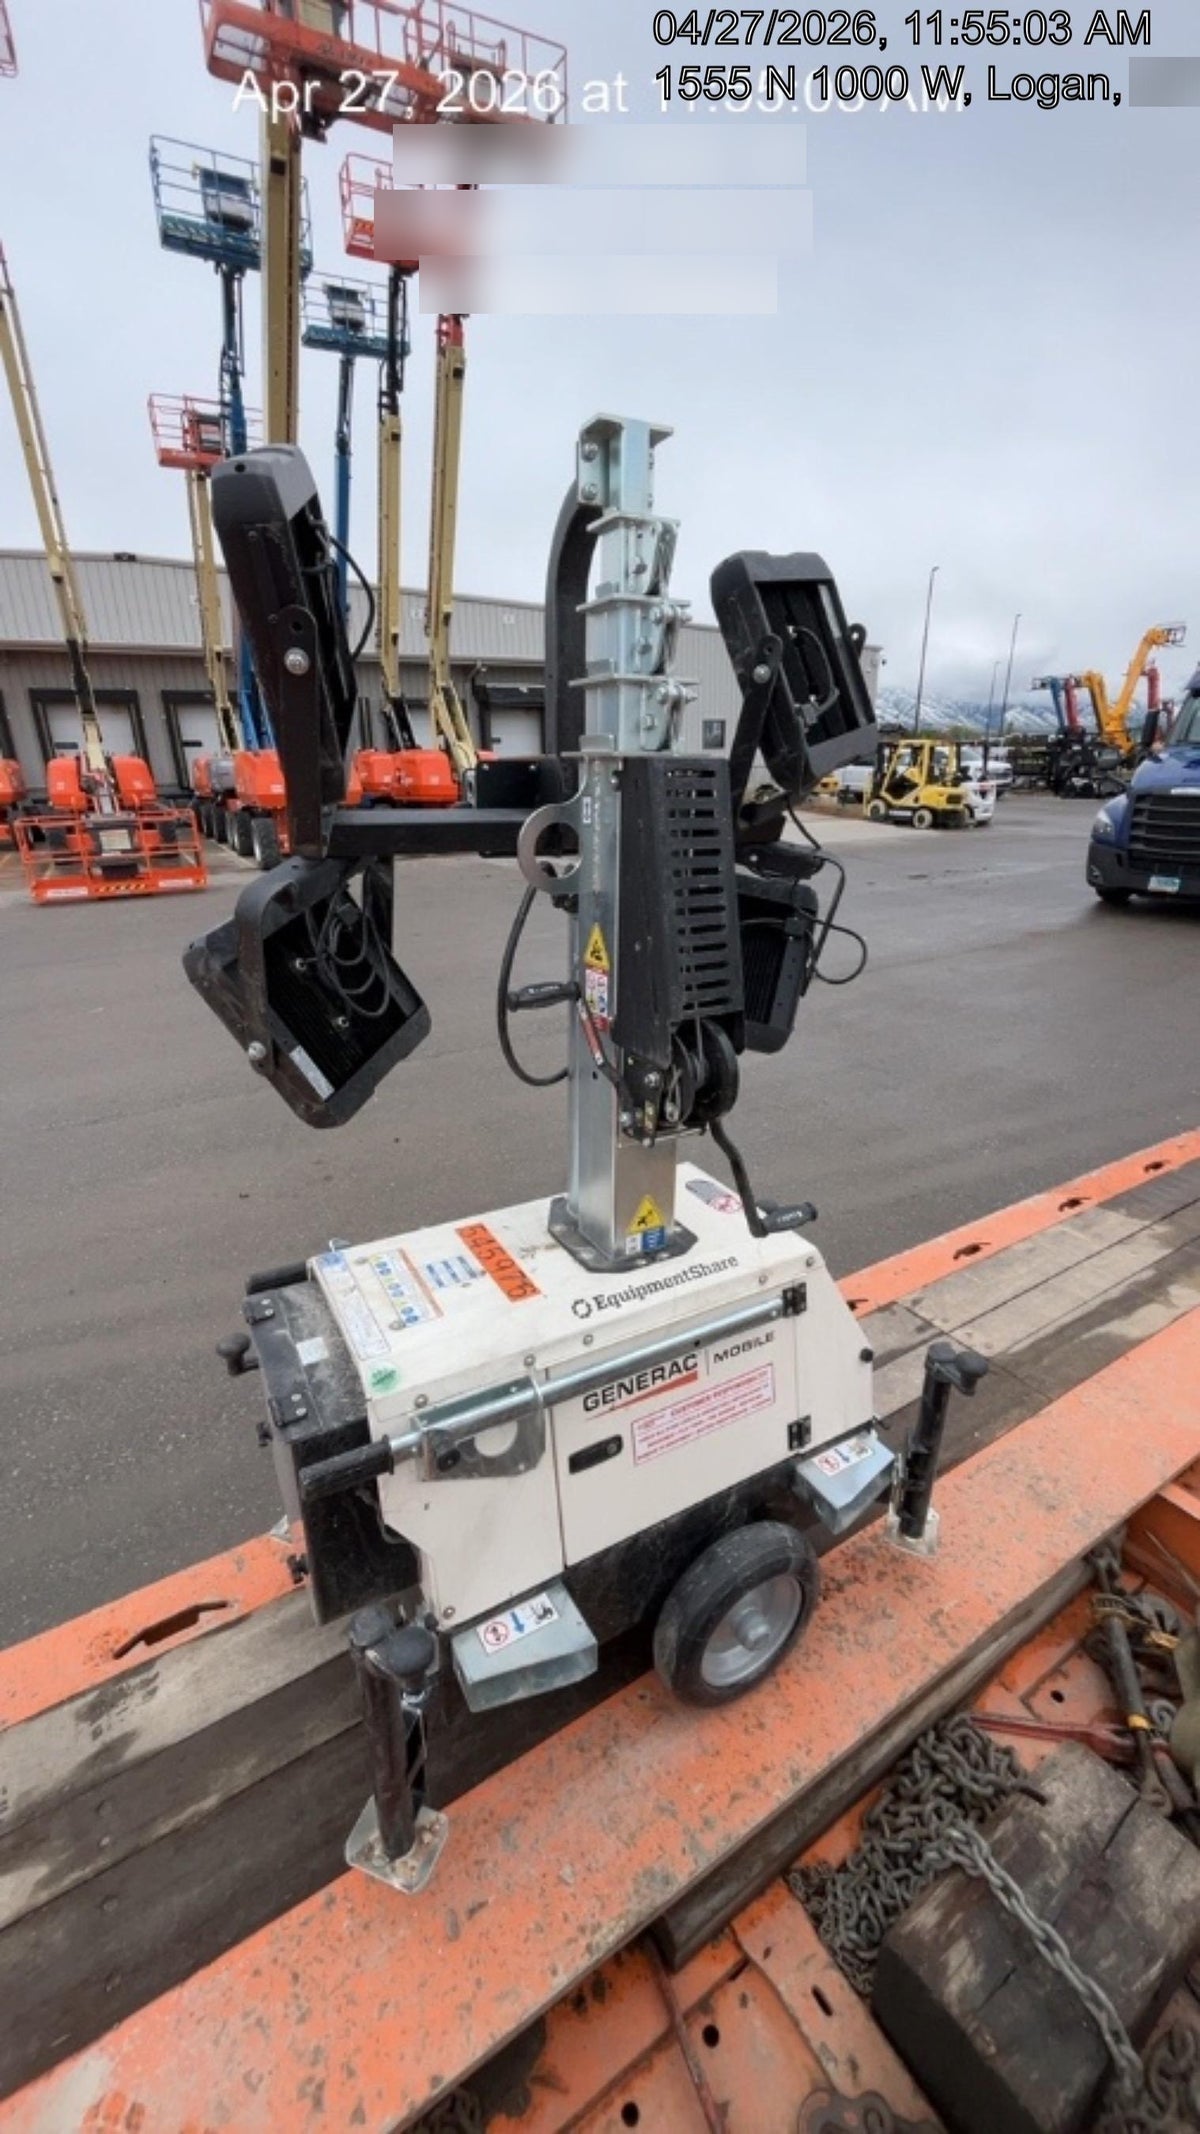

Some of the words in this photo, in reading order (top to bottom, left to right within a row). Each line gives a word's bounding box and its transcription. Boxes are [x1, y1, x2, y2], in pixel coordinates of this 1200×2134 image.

[592, 1254, 739, 1312] EquipmentShare
[582, 1353, 699, 1412] GENERAC
[712, 1331, 774, 1364] MOBILE
